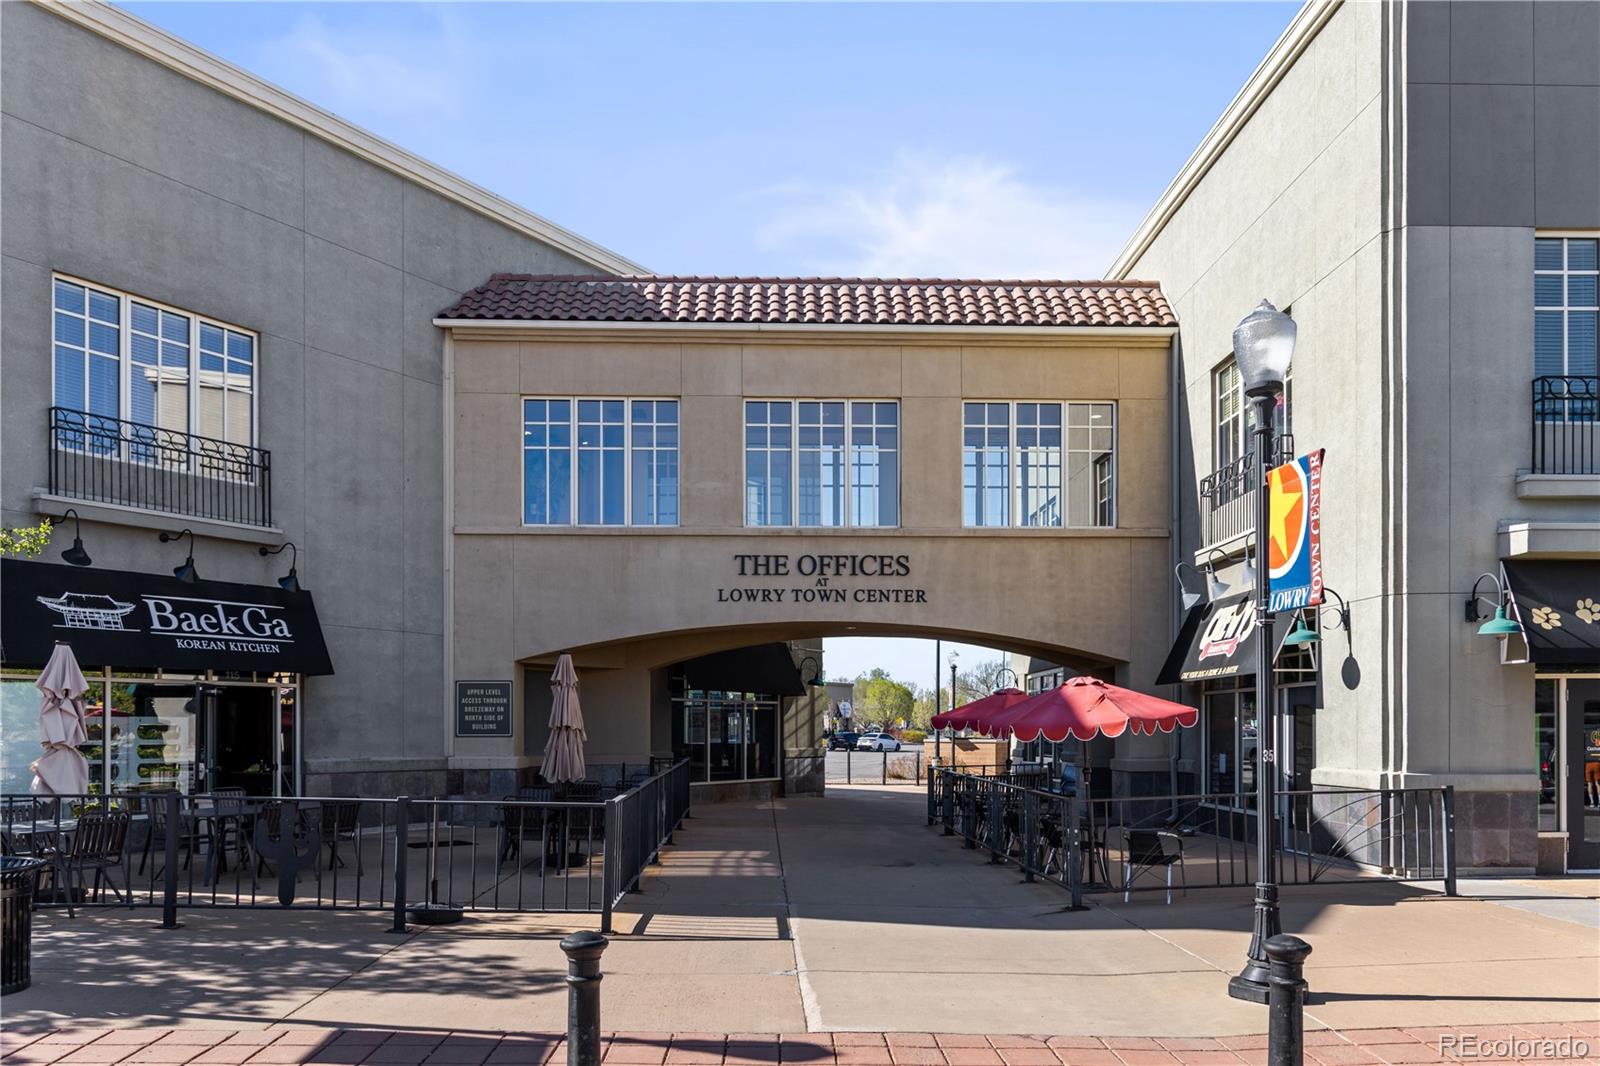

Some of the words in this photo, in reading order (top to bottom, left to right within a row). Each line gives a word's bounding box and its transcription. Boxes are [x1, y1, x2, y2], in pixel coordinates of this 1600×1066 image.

[1309, 452, 1321, 535] CENTER
[734, 555, 790, 576] THE
[797, 555, 911, 577] OFFICES
[1310, 543, 1322, 603] TOWN
[815, 578, 829, 587] AT
[718, 589, 786, 603] LOWRY
[791, 589, 847, 603] TOWN
[853, 589, 928, 603] CENTER
[1269, 587, 1310, 613] LOWRY
[176, 639, 226, 651] KOREAN
[229, 641, 280, 653] KITCHEN
[225, 671, 240, 679] 115
